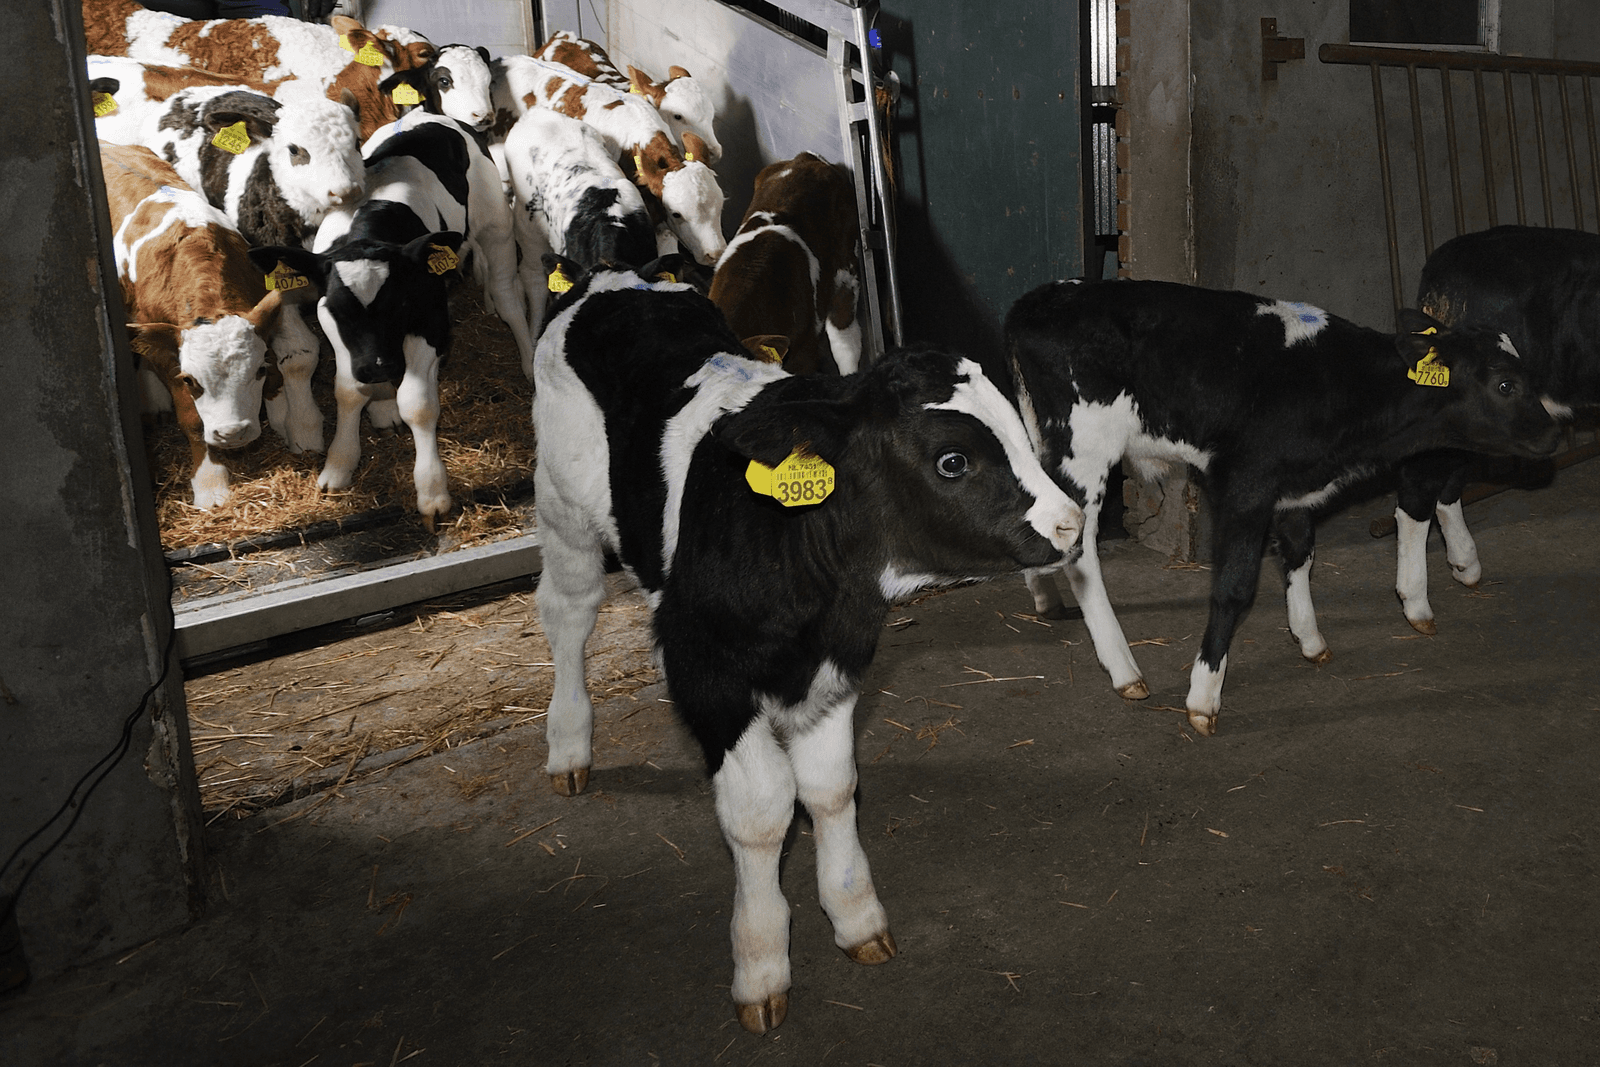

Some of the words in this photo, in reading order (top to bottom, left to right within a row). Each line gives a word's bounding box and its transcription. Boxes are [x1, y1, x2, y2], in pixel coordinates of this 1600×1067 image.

[435, 255, 456, 273] 4075
[275, 276, 303, 290] 4075
[1417, 371, 1445, 385] 7760
[778, 479, 827, 503] 3983
